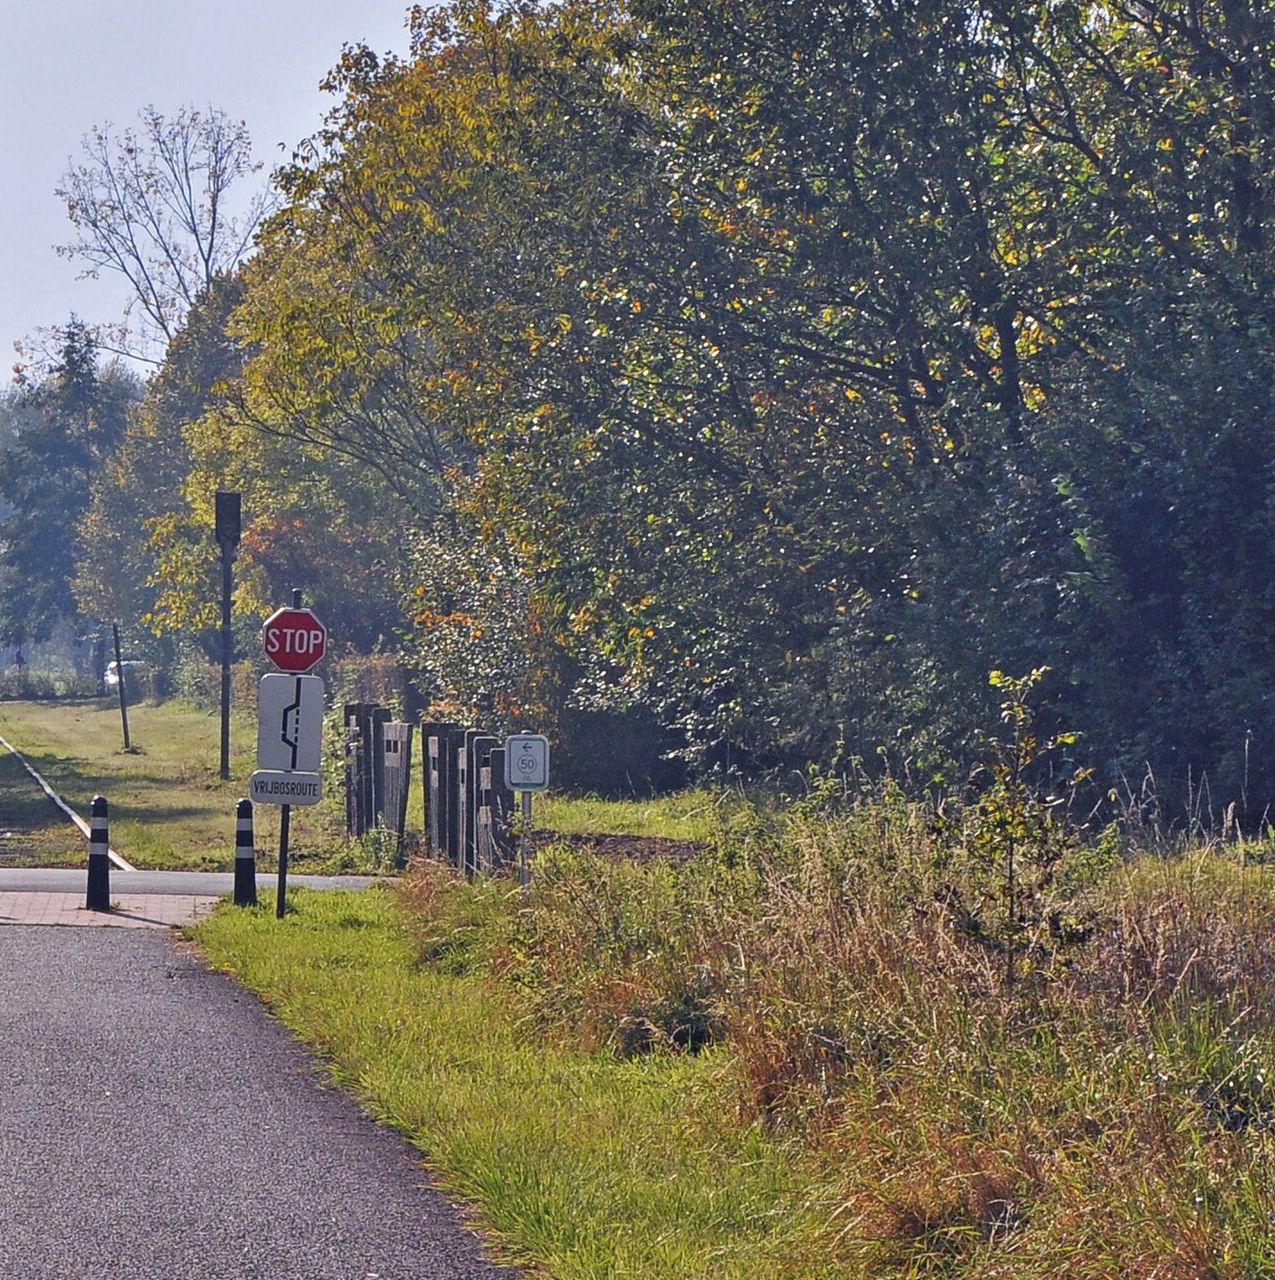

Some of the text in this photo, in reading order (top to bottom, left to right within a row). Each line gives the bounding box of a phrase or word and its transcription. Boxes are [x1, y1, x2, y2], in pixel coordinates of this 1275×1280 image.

[268, 628, 323, 654] STOP
[521, 759, 534, 769] 50
[254, 780, 318, 797] VRIJBOSROUTE
